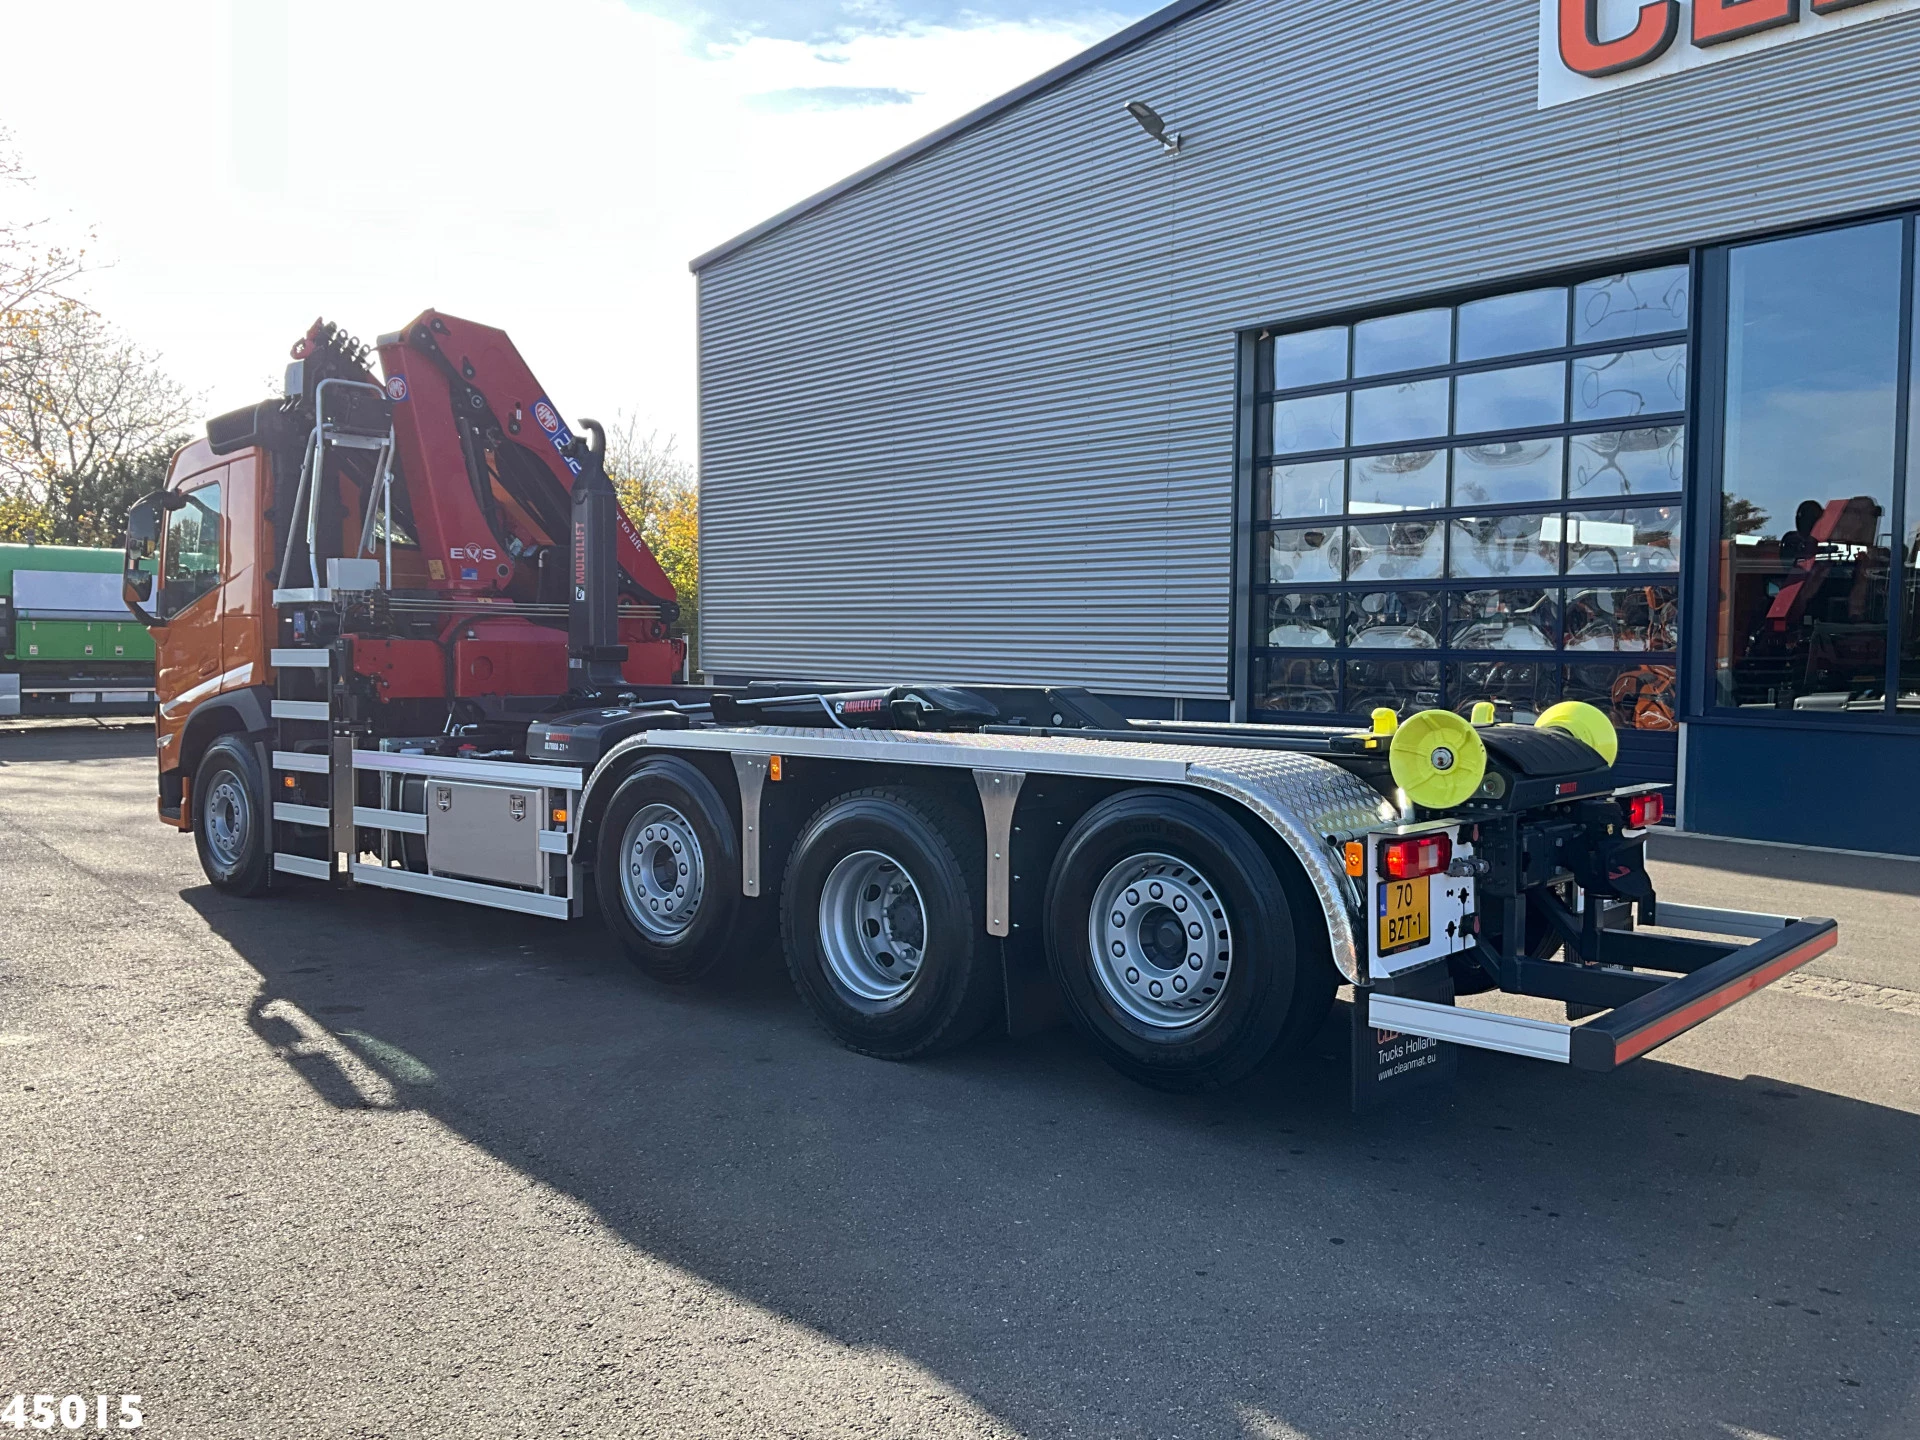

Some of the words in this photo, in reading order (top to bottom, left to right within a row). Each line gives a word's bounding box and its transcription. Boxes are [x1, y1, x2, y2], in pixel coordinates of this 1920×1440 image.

[537, 405, 555, 428] HMF
[621, 521, 630, 534] to
[575, 521, 585, 584] MULTILIFT
[844, 699, 882, 713] MULTILIFT
[1396, 883, 1413, 909] 70
[1388, 912, 1421, 943] BZT-1
[1378, 1044, 1403, 1065] Trucks
[1378, 1053, 1436, 1081] www.cleanmat.eu
